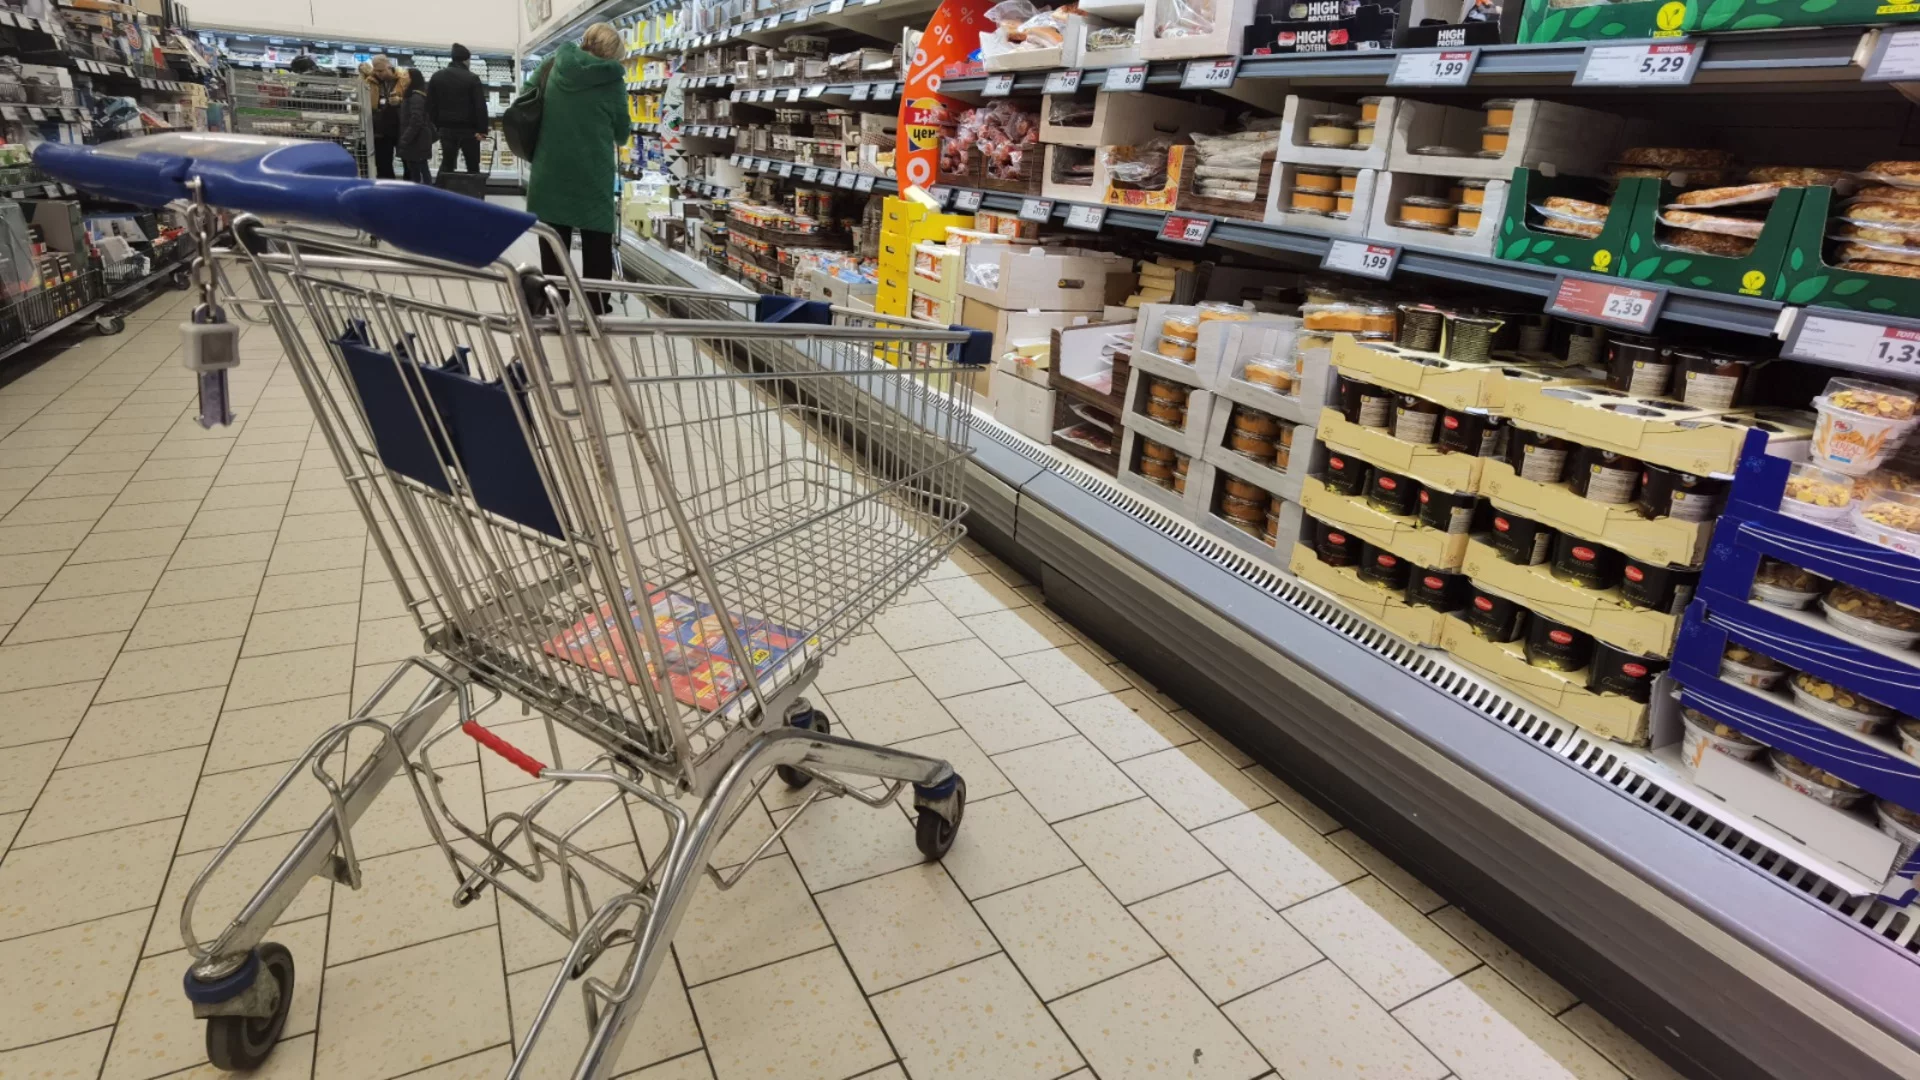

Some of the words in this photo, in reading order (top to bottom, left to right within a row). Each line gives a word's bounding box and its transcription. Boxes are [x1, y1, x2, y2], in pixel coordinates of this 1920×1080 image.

[1308, 1, 1339, 15] HIGH
[1296, 30, 1327, 44] HIGH
[1438, 28, 1465, 40] HIGH
[1296, 44, 1327, 52] PROTEIN
[1435, 62, 1463, 77] 1,99
[1640, 56, 1684, 76] 5,29
[1363, 254, 1387, 269] 1,99
[1609, 300, 1643, 316] 2,39
